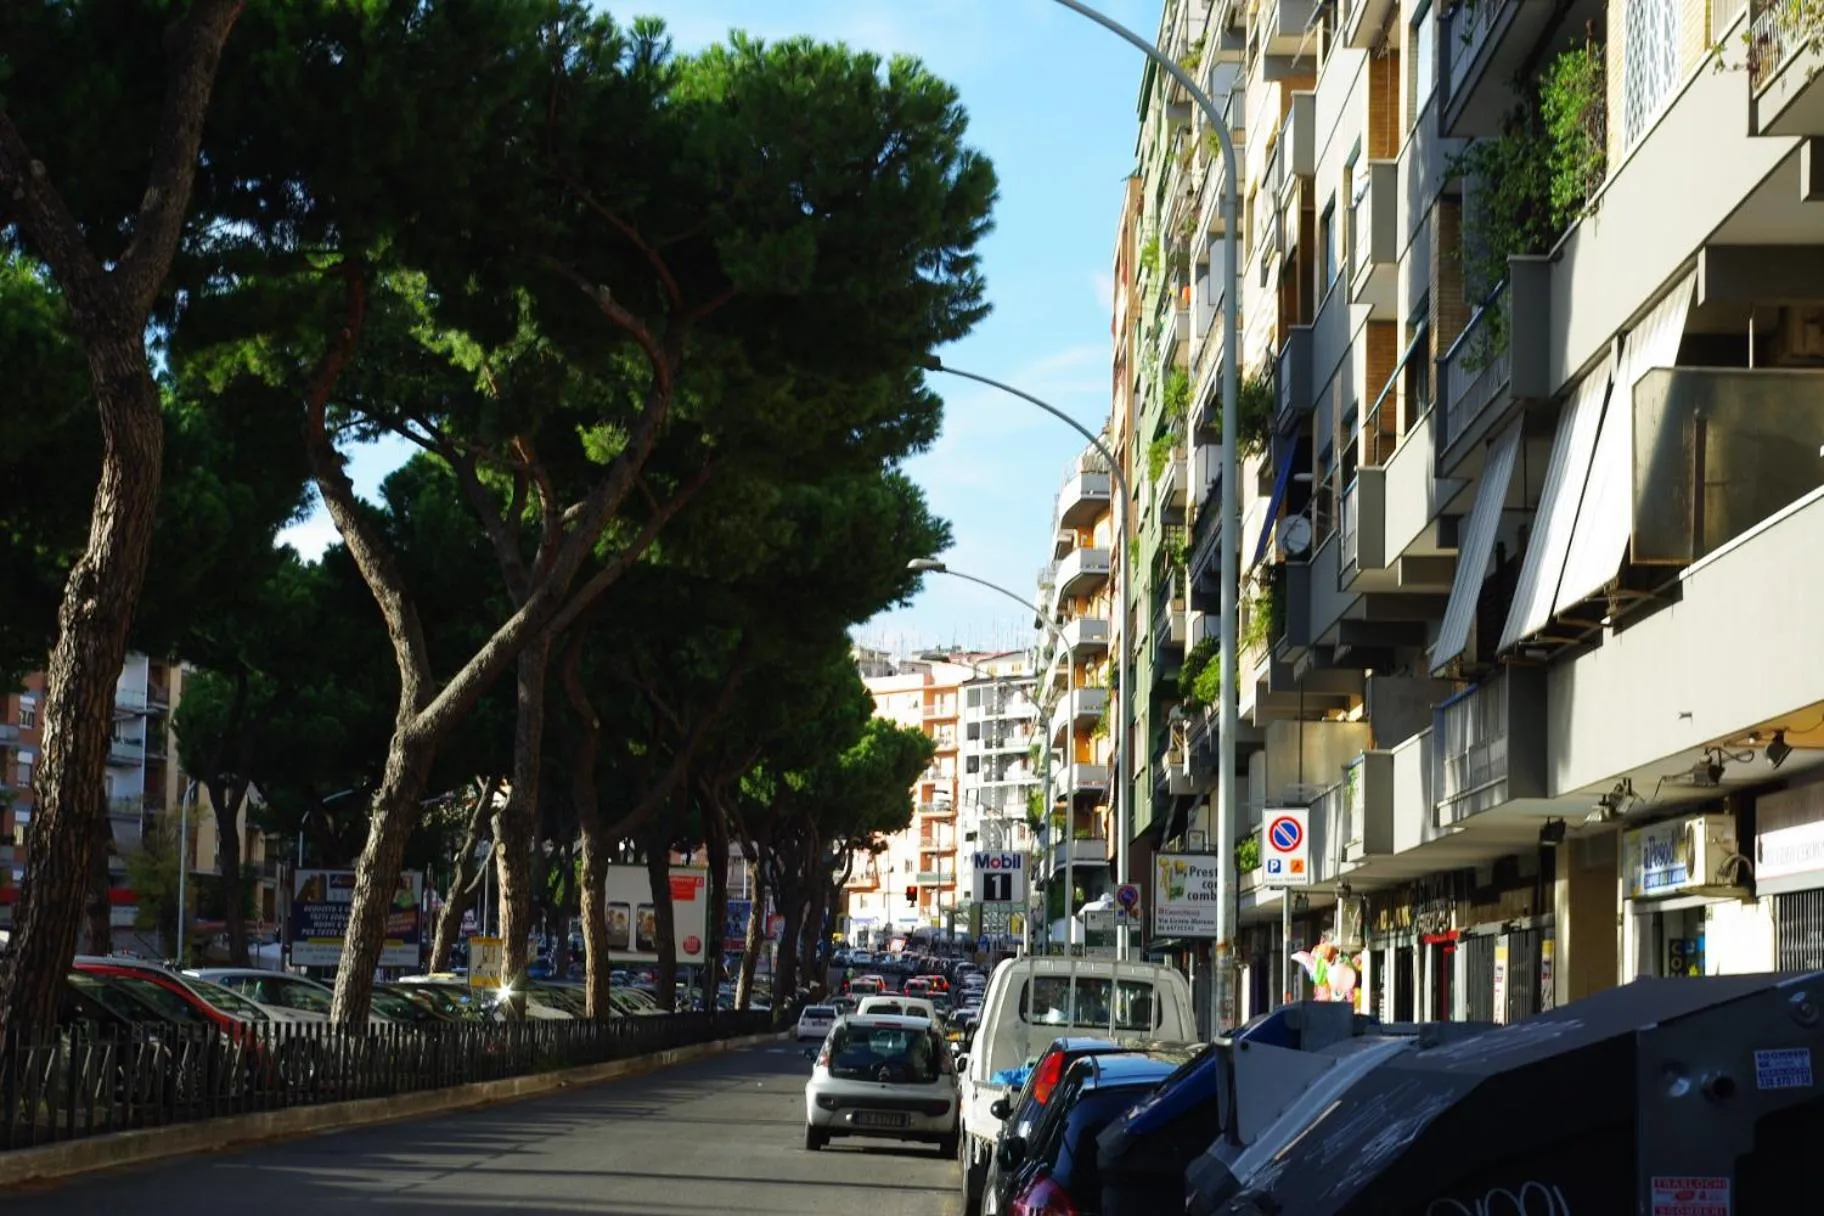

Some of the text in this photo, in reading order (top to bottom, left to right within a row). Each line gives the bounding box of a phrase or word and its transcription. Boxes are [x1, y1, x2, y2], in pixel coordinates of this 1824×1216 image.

[974, 852, 1021, 870] Mobil
[991, 875, 1002, 900] 1
[1654, 1178, 1728, 1190] TRASLOCHI
